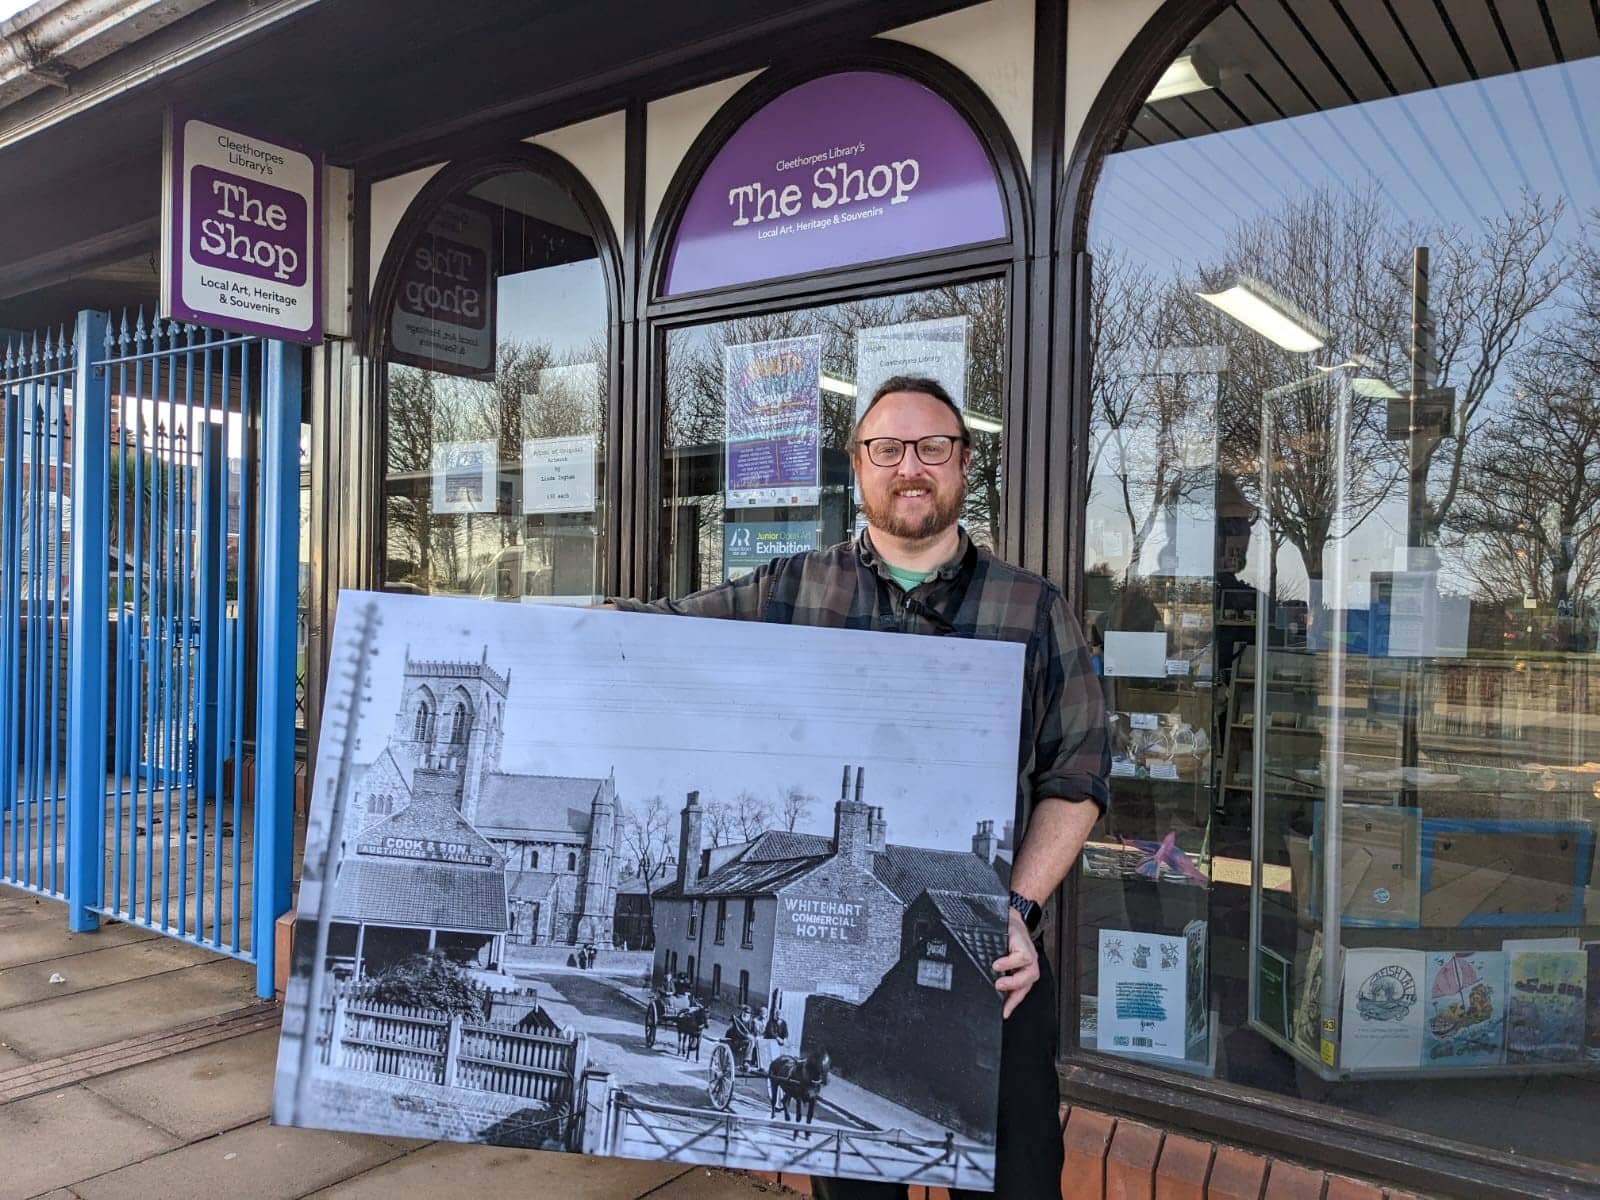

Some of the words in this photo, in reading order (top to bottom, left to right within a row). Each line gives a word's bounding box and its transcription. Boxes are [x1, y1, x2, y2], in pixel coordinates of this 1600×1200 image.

[217, 135, 284, 165] Cleethorpes
[776, 152, 828, 172] Cleethorpes
[829, 141, 866, 159] Library's
[229, 152, 273, 175] Library's
[729, 182, 802, 226] The
[812, 158, 920, 209] Shop
[212, 180, 288, 231] The
[758, 229, 778, 240] Local
[779, 224, 795, 236] Art,
[797, 217, 832, 232] Heritage
[833, 214, 840, 224] &
[841, 206, 884, 223] Souvenirs
[200, 218, 298, 280] Shop
[201, 275, 229, 292] Local
[231, 282, 251, 297] Art,
[254, 288, 297, 306] Heritage
[219, 293, 227, 304] &
[229, 296, 281, 315] Souvenirs
[756, 532, 779, 540] Junior
[756, 541, 811, 554] Exhibition
[386, 838, 424, 850] COOK
[427, 841, 435, 852] &
[791, 913, 857, 927] COMMERCIAL
[796, 924, 848, 940] HOTEL
